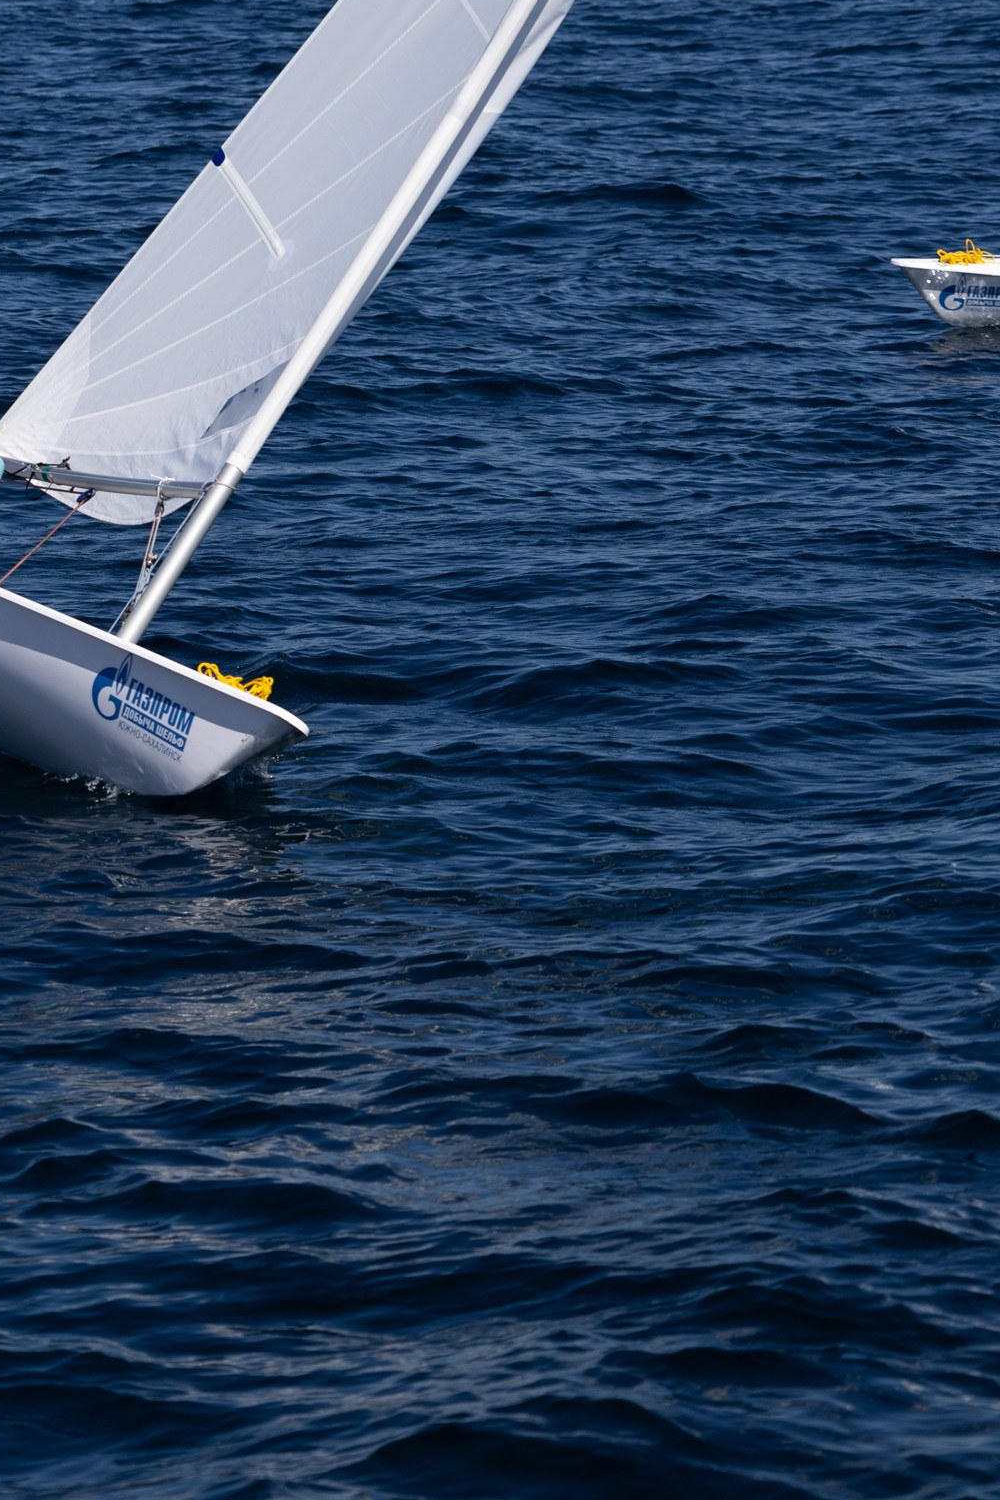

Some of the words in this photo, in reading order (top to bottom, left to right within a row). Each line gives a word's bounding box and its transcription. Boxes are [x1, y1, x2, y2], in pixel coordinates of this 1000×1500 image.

[123, 706, 155, 732] ДОБЫЧА
[155, 724, 184, 748] ШЕЛЬФ
[126, 677, 195, 735] ГАЗПРОМ
[118, 720, 182, 763] ЮЖНО-САХАЛИНСК
